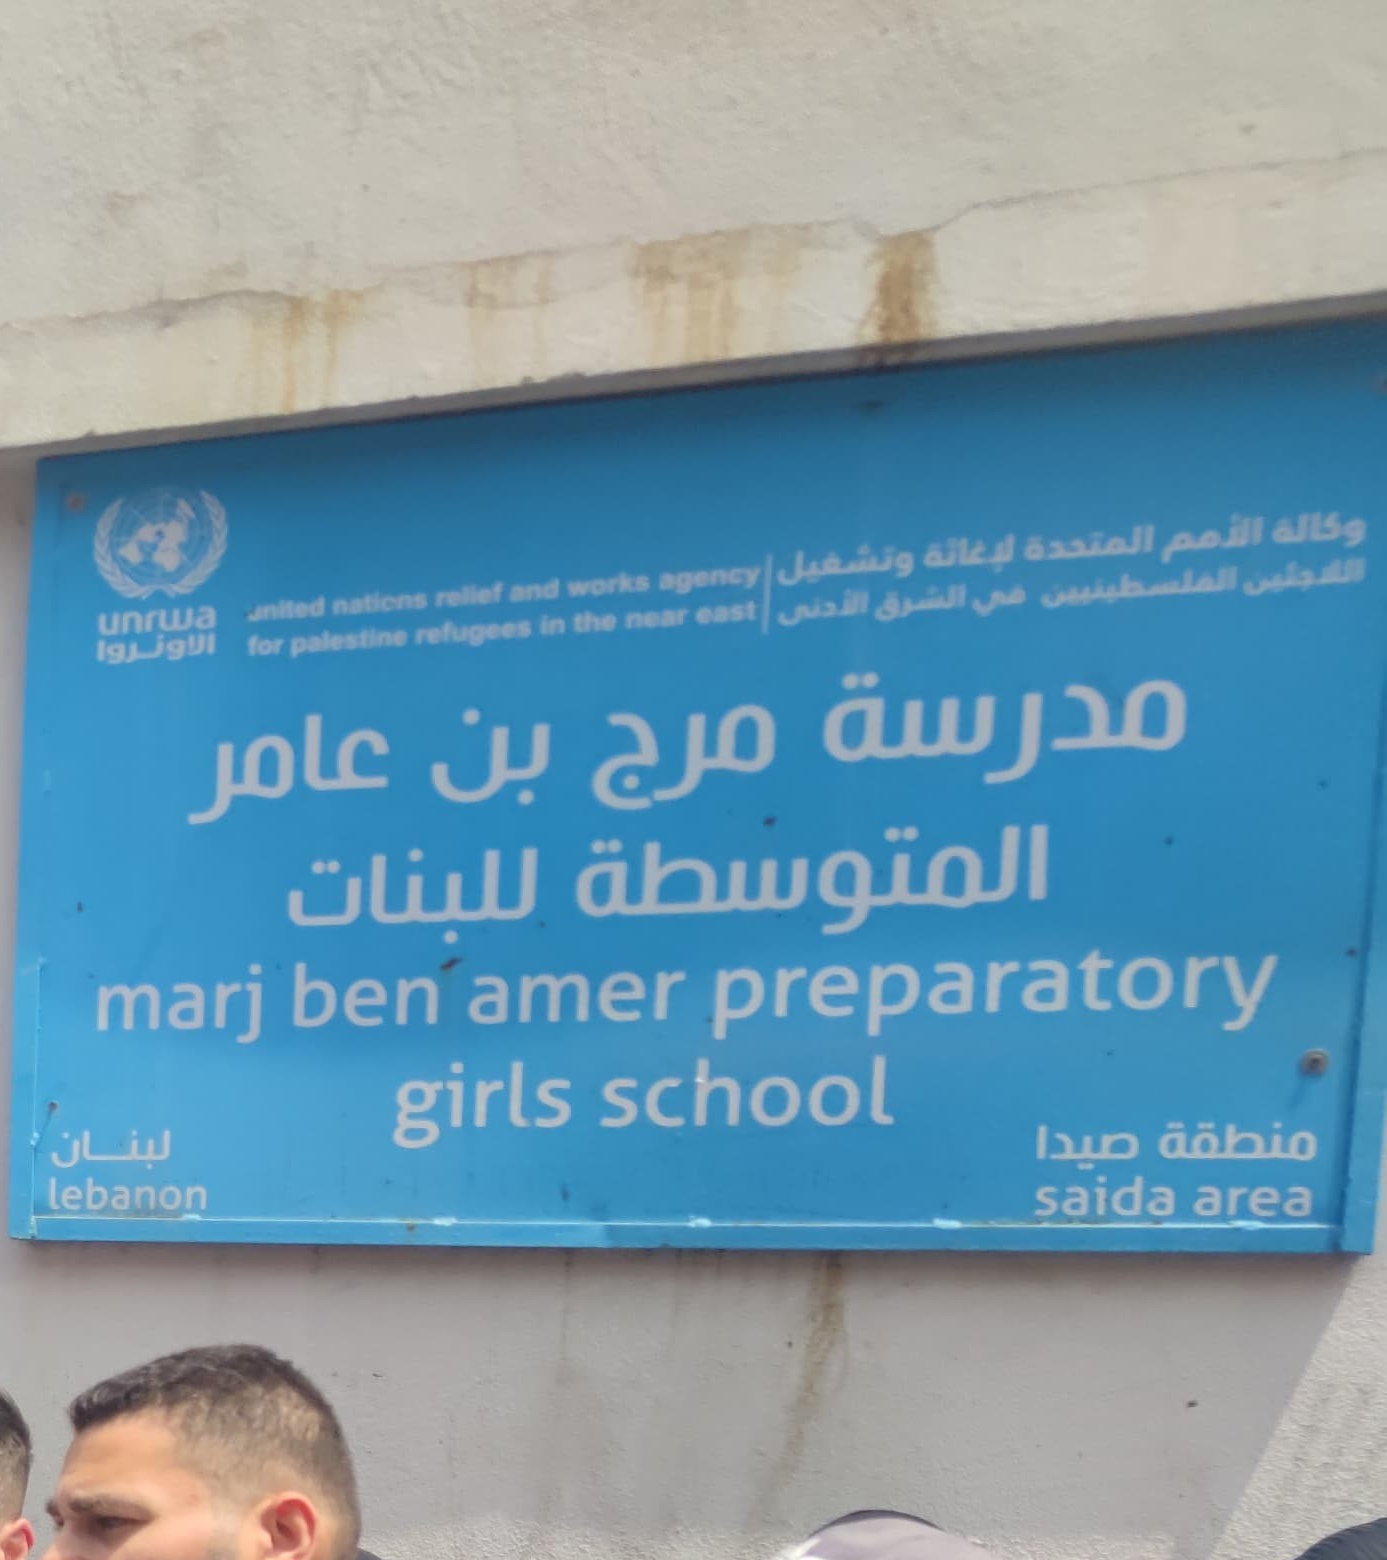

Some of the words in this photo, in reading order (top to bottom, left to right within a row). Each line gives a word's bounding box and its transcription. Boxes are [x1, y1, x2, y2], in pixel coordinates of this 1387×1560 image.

[1023, 524, 1155, 561] المتحدة
[1271, 510, 1367, 547] وكالة
[777, 544, 915, 586] وتشغيل
[1040, 566, 1238, 609] الفلسطينيين
[331, 592, 428, 615] nations
[434, 581, 504, 607] relief
[508, 578, 560, 602] and
[567, 572, 651, 597] works
[658, 565, 762, 595] agency
[874, 583, 967, 622] الشرق
[971, 586, 1026, 617] في
[96, 605, 217, 637] unrwa
[247, 634, 285, 656] for
[289, 628, 408, 658] palestine
[414, 619, 532, 647] refugees
[539, 614, 566, 636] in
[572, 610, 618, 633] the
[624, 606, 689, 629] near
[695, 600, 758, 625] east
[822, 671, 1188, 785] مدرسة
[186, 712, 390, 826] عامر
[430, 708, 551, 806] بن
[590, 703, 777, 811] مرج
[287, 846, 539, 945] للبنات
[575, 823, 1049, 936] المتوسطة
[96, 962, 263, 1045] marj
[292, 961, 440, 1029] ben
[467, 970, 687, 1025] amer
[711, 948, 1279, 1041] preparatory
[392, 1059, 572, 1150] girls
[599, 1053, 895, 1129] school
[50, 1129, 172, 1170] لبنان
[1035, 1124, 1140, 1171] صيدا
[1157, 1121, 1318, 1162] منطقة
[48, 1176, 208, 1212] lebanon
[1034, 1175, 1176, 1218] saida
[1192, 1184, 1313, 1218] area
